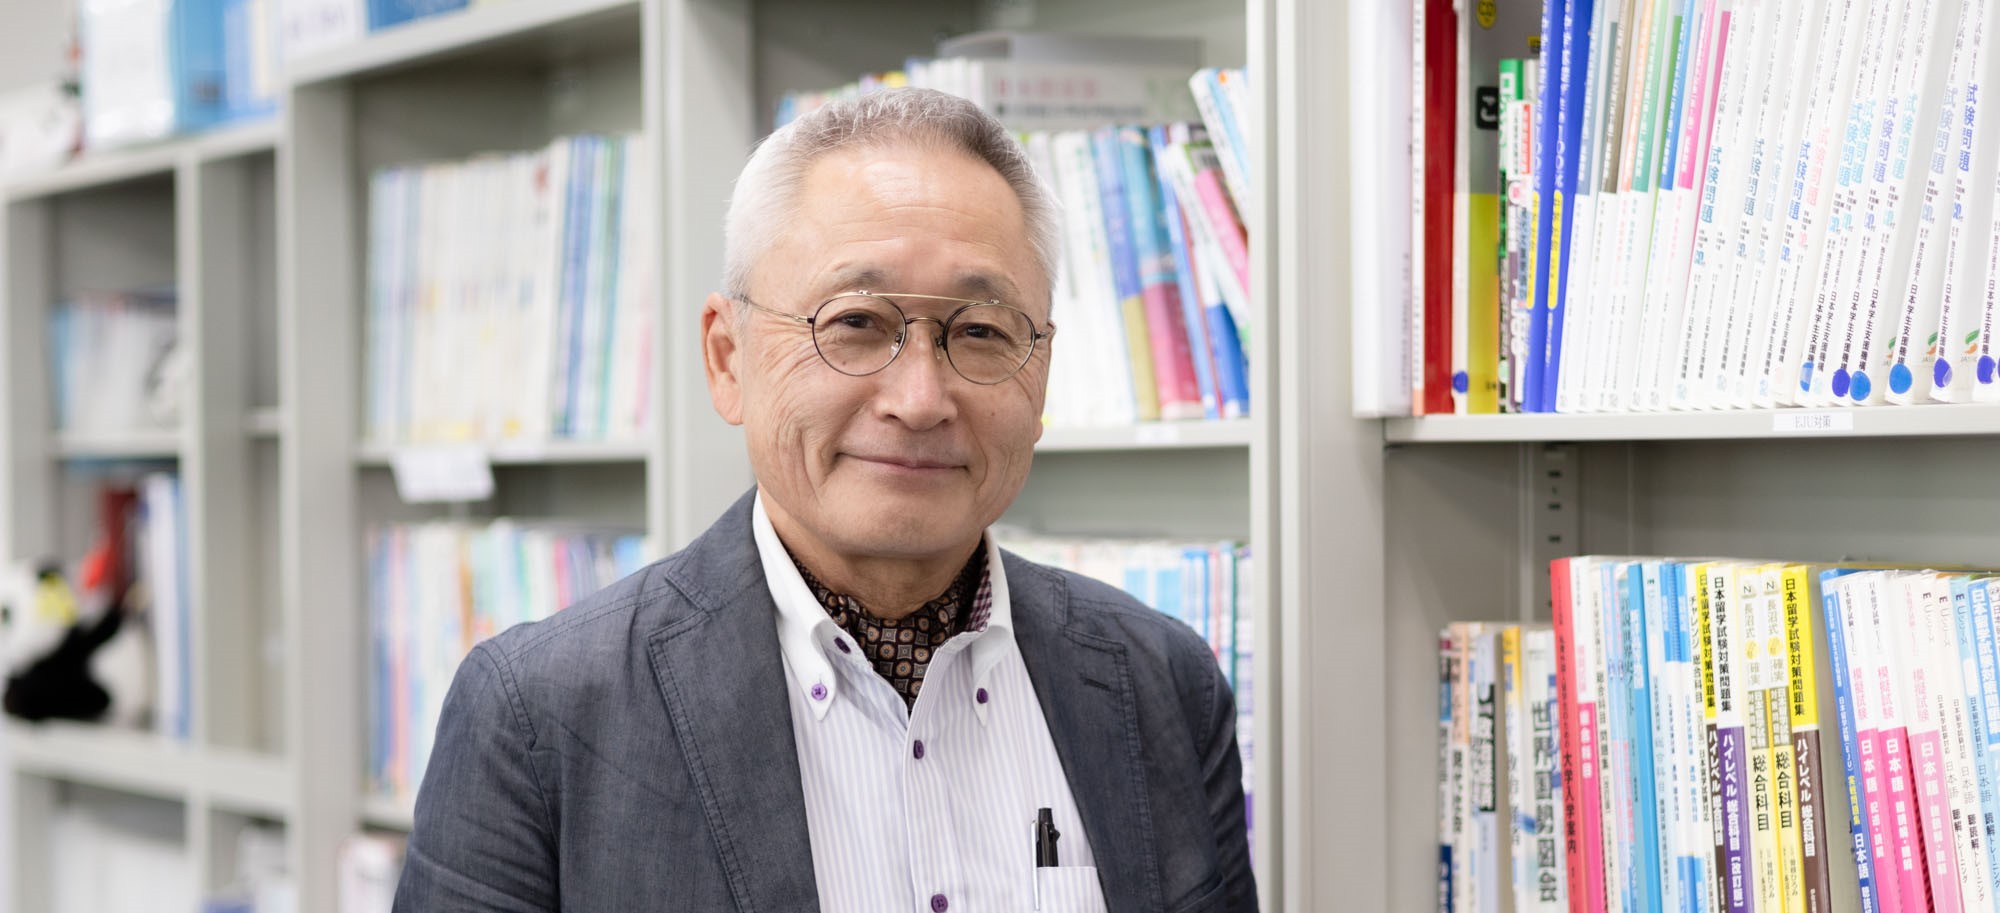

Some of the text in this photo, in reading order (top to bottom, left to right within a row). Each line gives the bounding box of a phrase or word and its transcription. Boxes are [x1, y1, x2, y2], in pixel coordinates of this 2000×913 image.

[1838, 100, 1863, 186] 試験問題
[1852, 98, 1876, 183] 試験問題
[1874, 96, 1898, 183] 試験問題
[1893, 93, 1918, 180] 試験問題
[1931, 86, 1958, 174] 試験問題
[1960, 83, 1979, 171] 試験問題
[1702, 146, 1722, 224] 試験問題
[1744, 137, 1765, 216] 試験問題
[1789, 140, 1811, 220] 試験問題
[1807, 293, 1825, 361] 日本学生支援機
[1938, 283, 1952, 356] 日本学生支援機
[1981, 279, 1995, 355] 日本学生支援機
[1690, 596, 1701, 650] チャレンジ
[1743, 585, 1752, 594] N
[1766, 581, 1775, 590] N
[1700, 574, 1716, 708] 日本留学試験対策問題集
[1714, 577, 1732, 712] 日本留学試験対策問題集
[1596, 671, 1607, 724] 総合科目
[1693, 655, 1703, 704] 総合科目
[1785, 578, 1816, 857] 日本留学試験対策問題集 ハイレベル 総合科目
[1709, 731, 1721, 795] ハイレベル
[1723, 735, 1737, 798] ハイレベル
[1752, 754, 1770, 831] 総合科目
[1775, 751, 1792, 828] 総合科目
[1861, 738, 1877, 793] 日本語
[1886, 738, 1904, 793] 日本語
[1921, 741, 1940, 797] 日本語
[1979, 765, 1993, 804] 日本語
[1531, 700, 1558, 903] 世界国勢図会
[1563, 751, 1577, 855] 大学入学案内
[1712, 795, 1724, 846] 総合科目
[1726, 799, 1740, 851] 総合科目
[1854, 833, 1870, 880] 日本語
